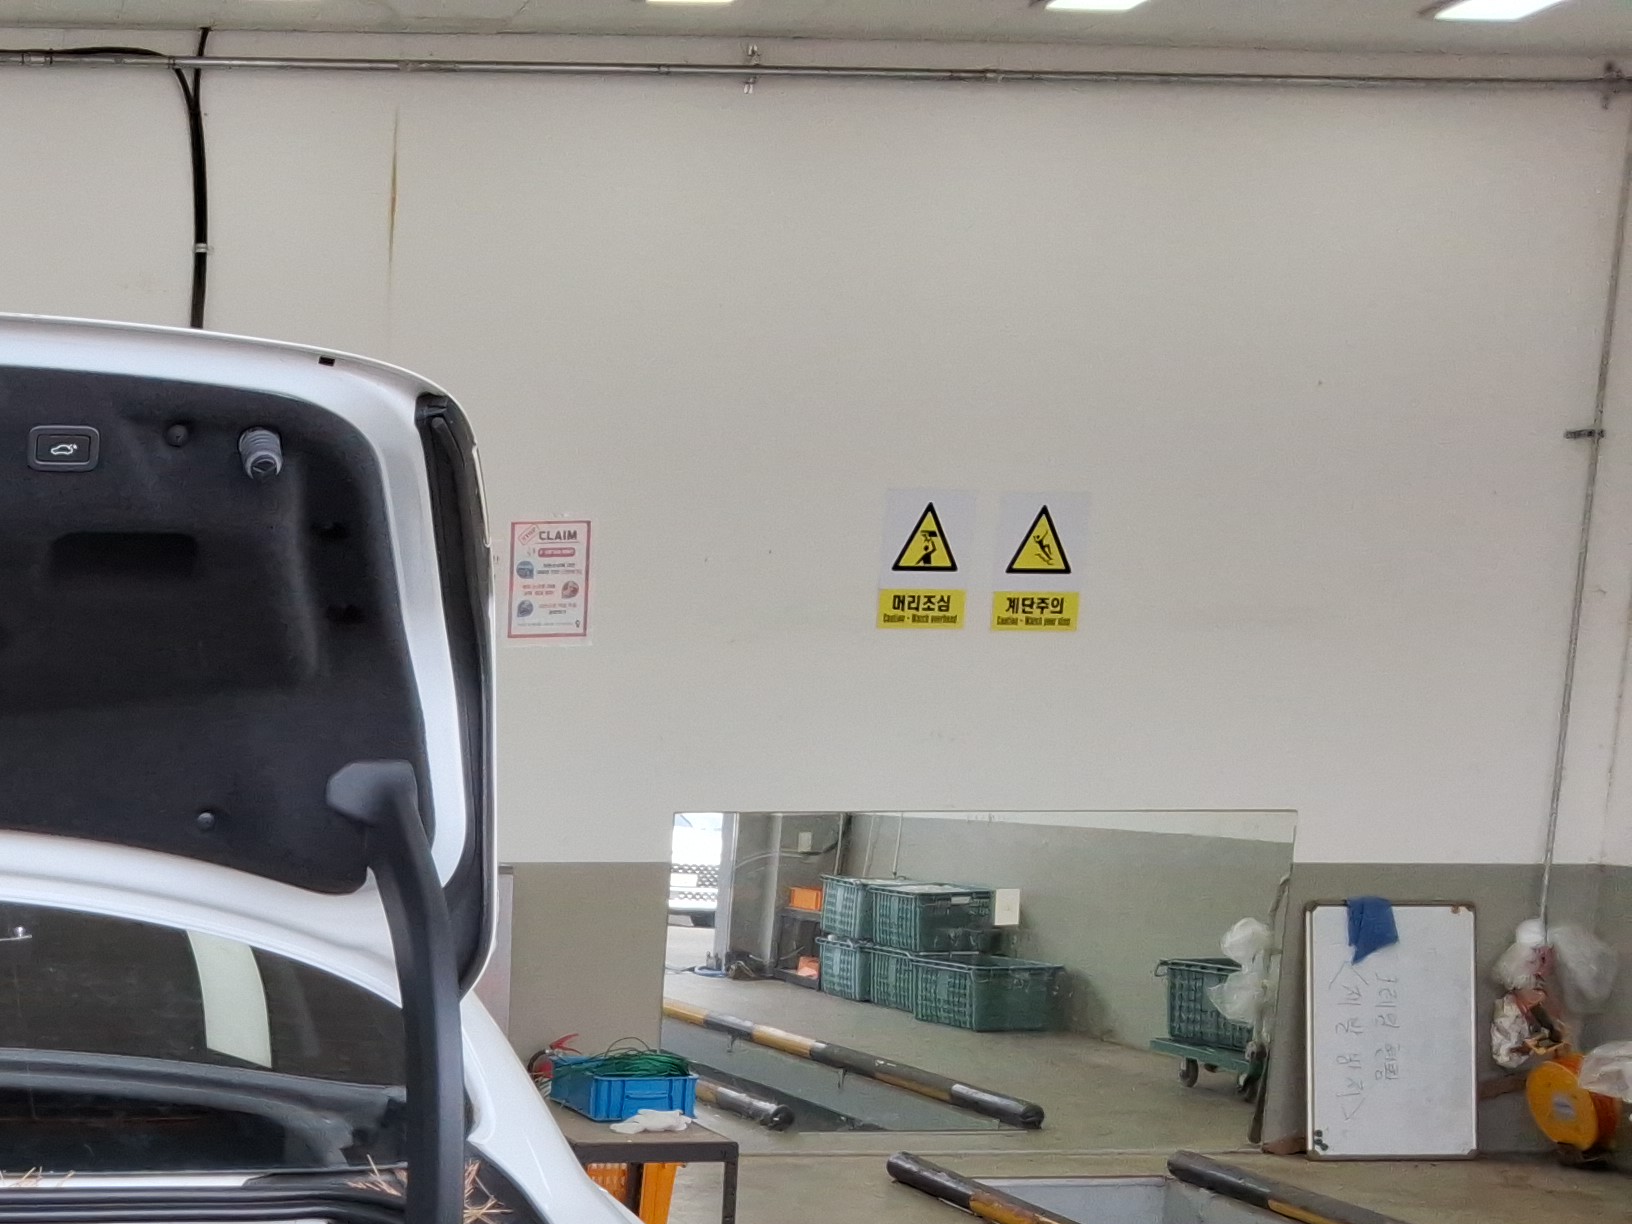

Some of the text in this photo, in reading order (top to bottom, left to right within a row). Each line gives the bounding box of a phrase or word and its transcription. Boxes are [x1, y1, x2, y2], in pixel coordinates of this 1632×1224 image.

[539, 531, 577, 541] CLAIM
[892, 594, 951, 613] 머리조심
[1005, 597, 1065, 615] 계단주의
